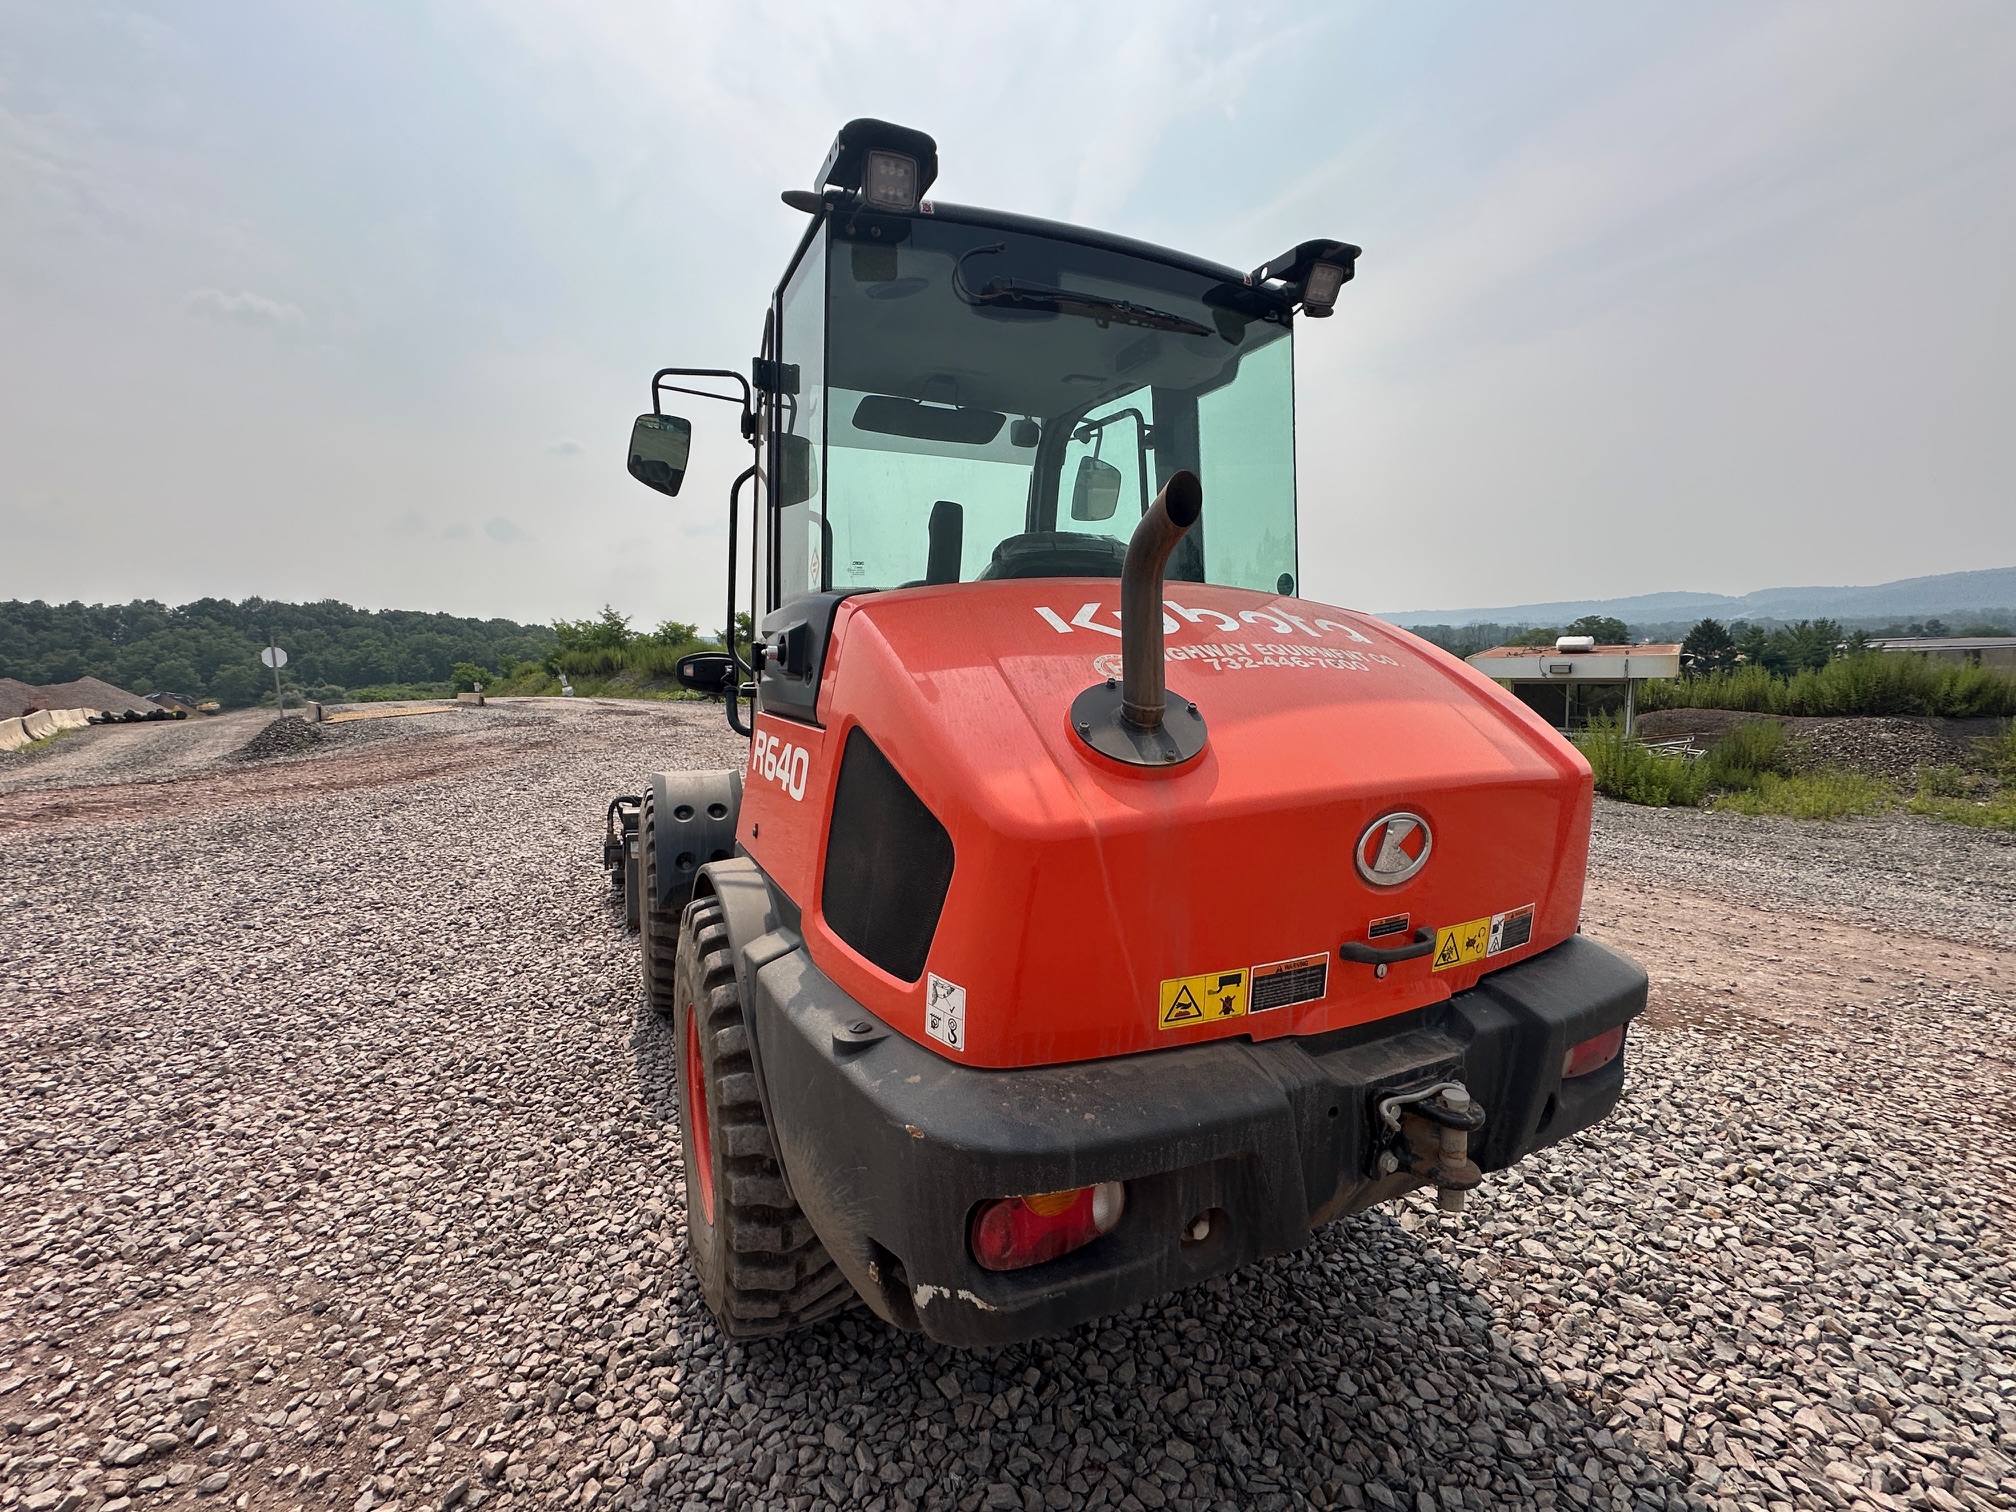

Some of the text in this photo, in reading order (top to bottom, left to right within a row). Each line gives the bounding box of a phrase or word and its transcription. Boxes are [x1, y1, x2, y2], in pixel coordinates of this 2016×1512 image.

[1251, 643, 1371, 662] EQUIPMENT
[1202, 656, 1370, 671] 732-446-7600
[752, 729, 809, 802] R640
